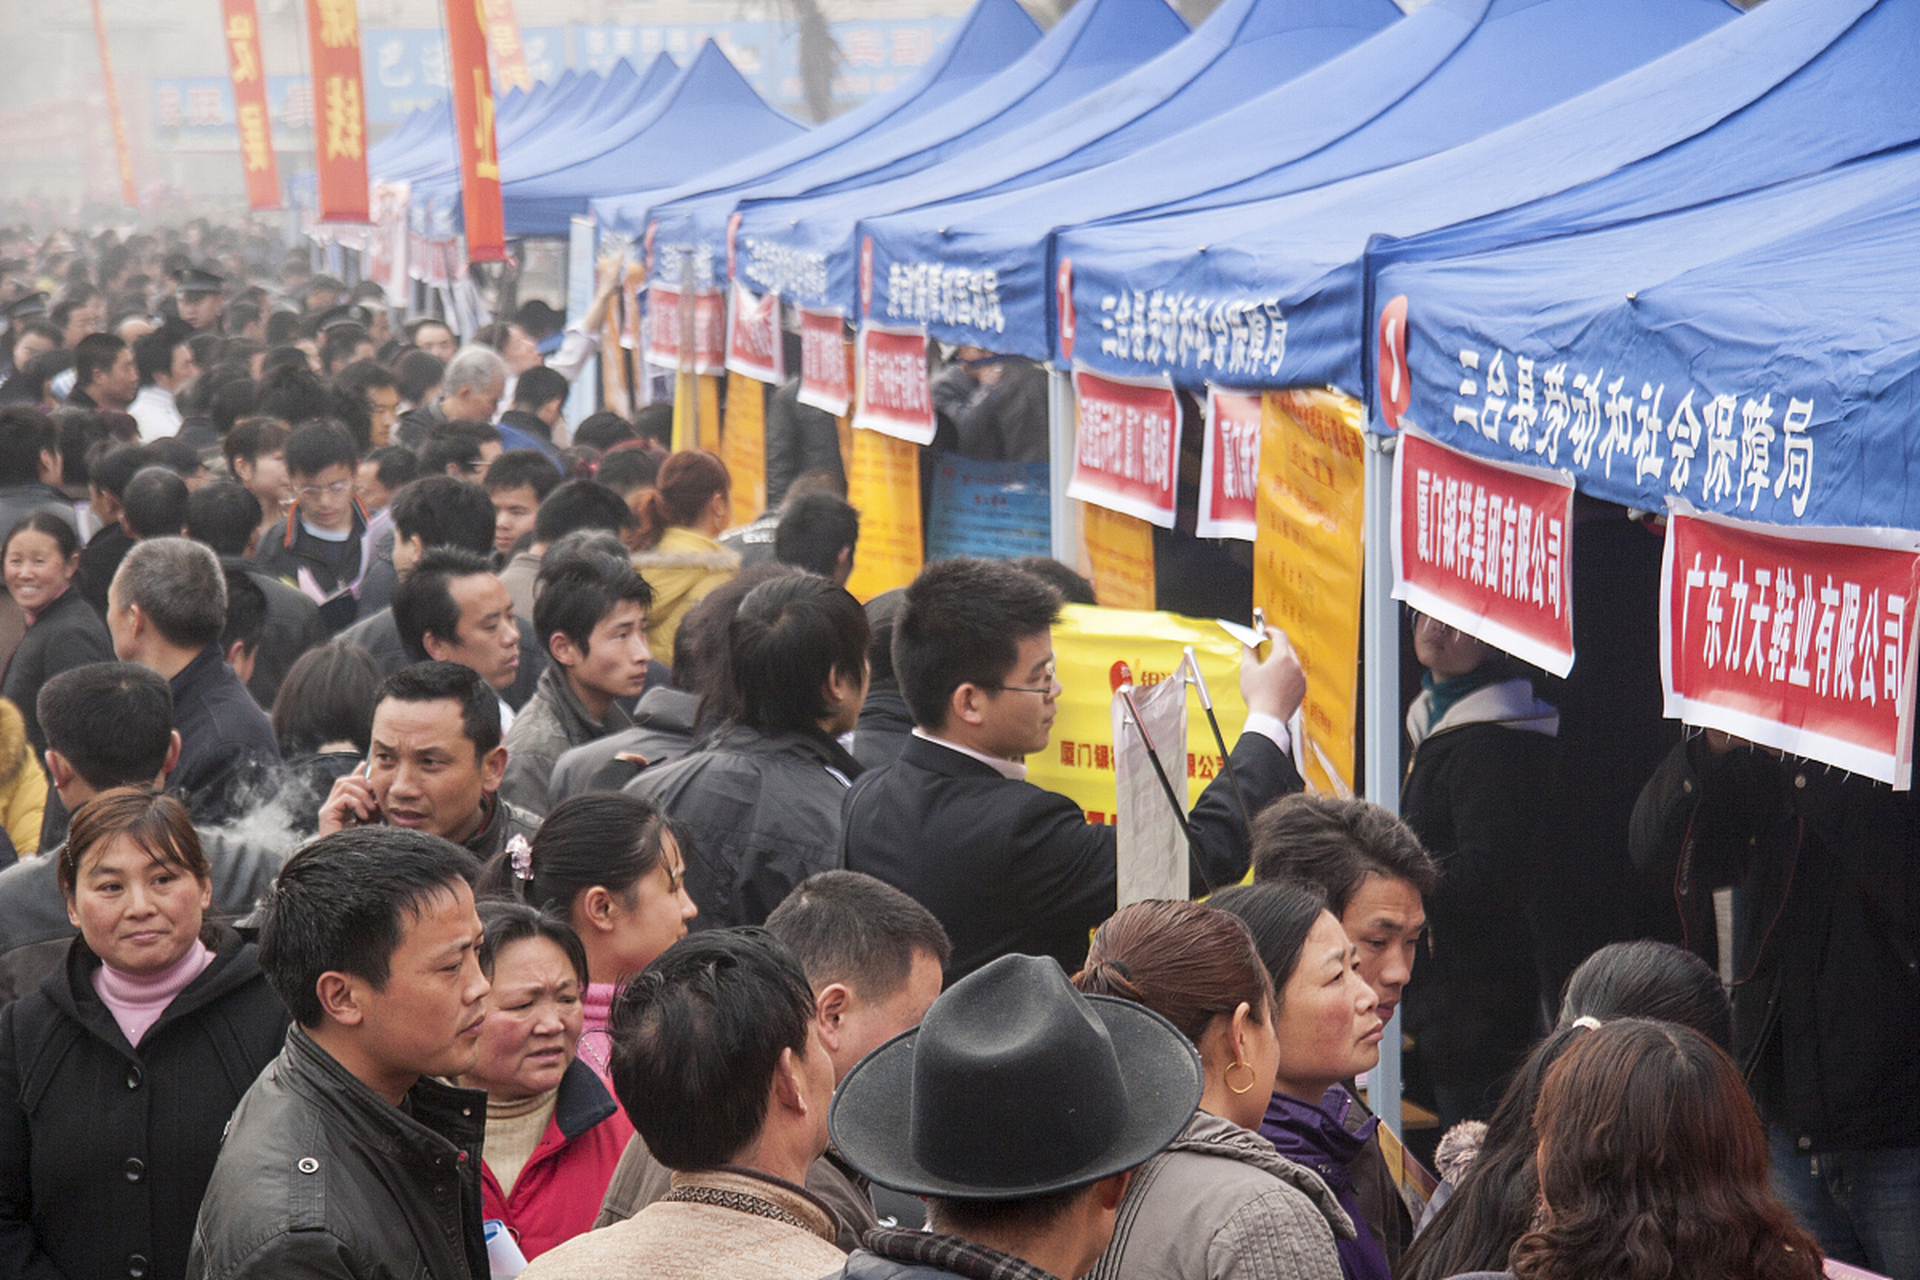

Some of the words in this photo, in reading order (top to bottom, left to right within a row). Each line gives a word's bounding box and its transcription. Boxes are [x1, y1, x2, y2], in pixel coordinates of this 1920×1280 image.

[1453, 348, 1814, 518] 三台县劳动和社会保障局
[1416, 469, 1562, 620] 厦门银祥集团有限公司
[1682, 551, 1905, 717] 广东力天鞋业有限公司
